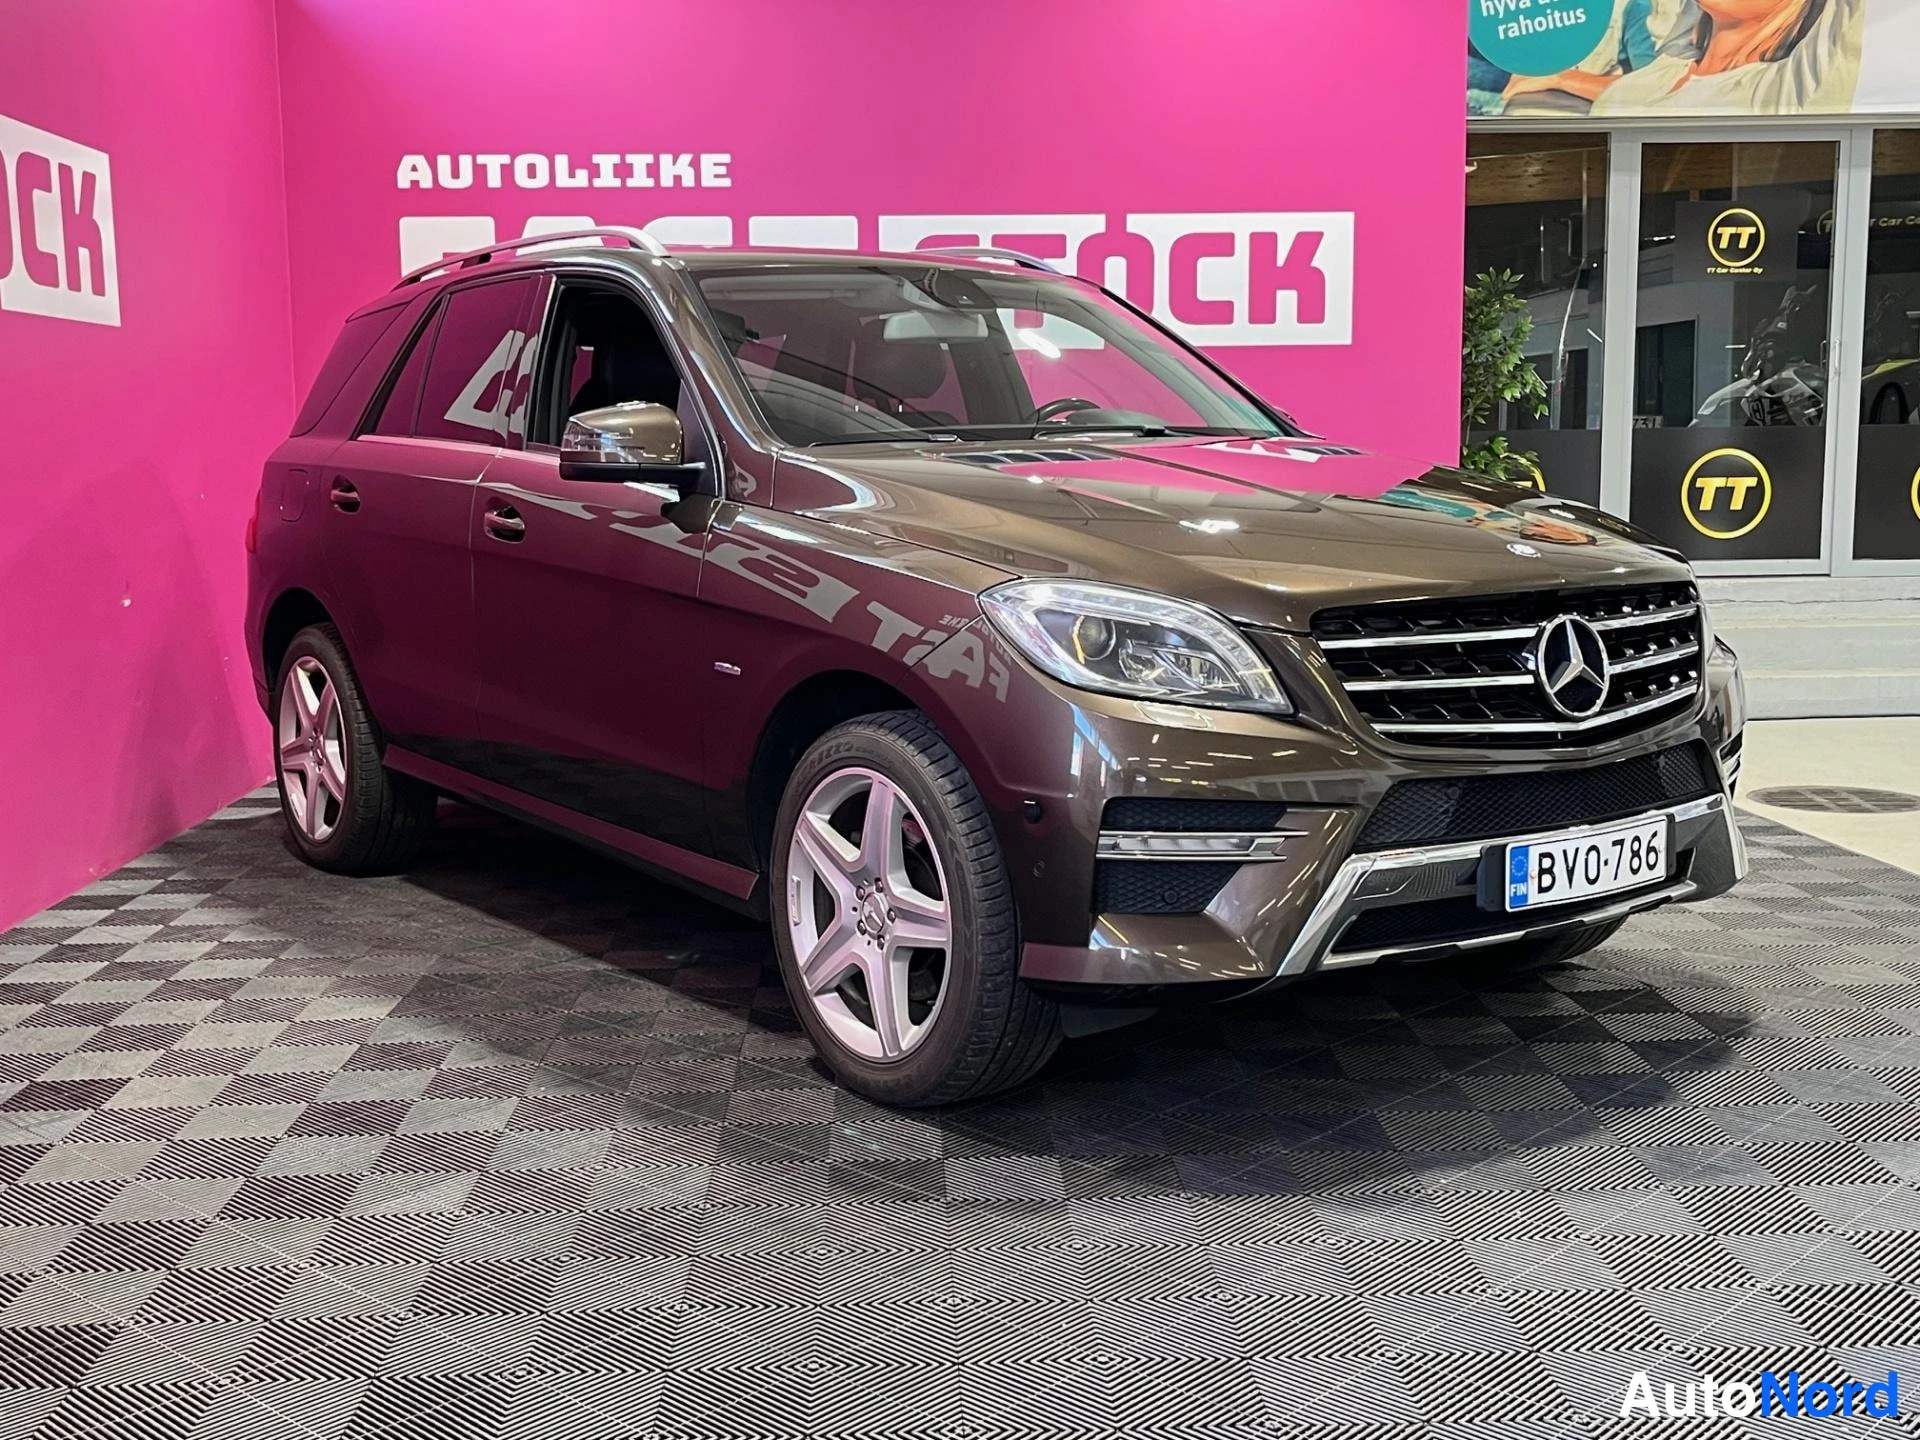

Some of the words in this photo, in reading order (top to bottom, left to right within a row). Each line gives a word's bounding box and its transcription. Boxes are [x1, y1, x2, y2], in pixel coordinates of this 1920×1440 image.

[1497, 8, 1586, 40] rahoitus
[396, 152, 732, 189] AUTOLIIKE
[1716, 226, 1757, 249] TT
[915, 230, 1327, 328] TOCK
[1695, 476, 1758, 511] TT
[1537, 830, 1659, 894] BVO-786
[1510, 882, 1528, 898] FIN
